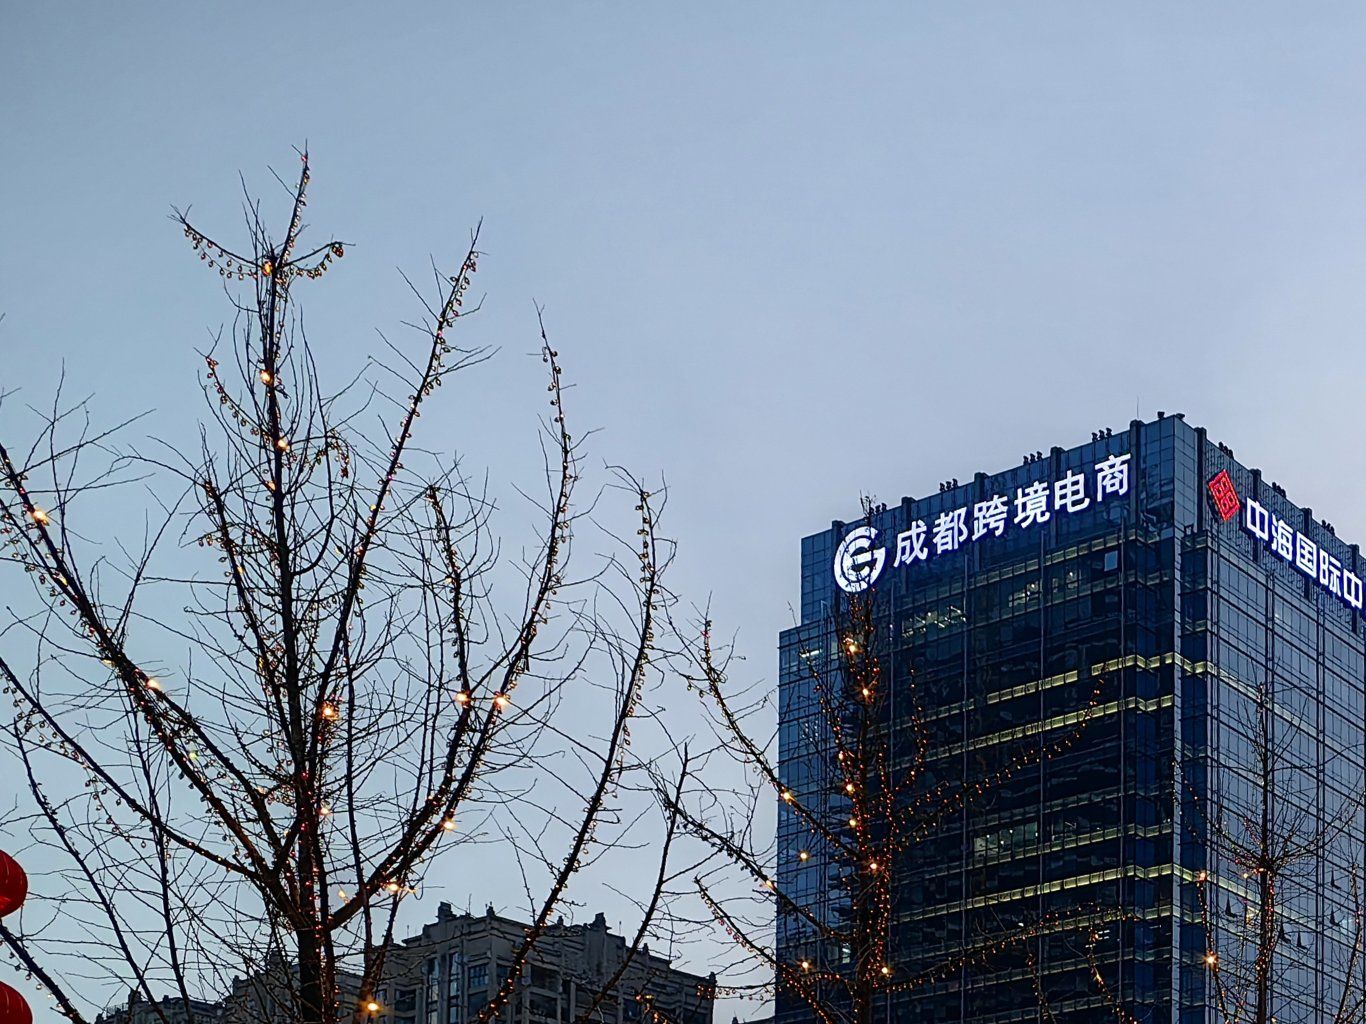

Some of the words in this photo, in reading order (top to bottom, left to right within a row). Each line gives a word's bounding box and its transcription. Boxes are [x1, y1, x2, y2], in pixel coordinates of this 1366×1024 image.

[893, 452, 1131, 568] 成都跨境电商
